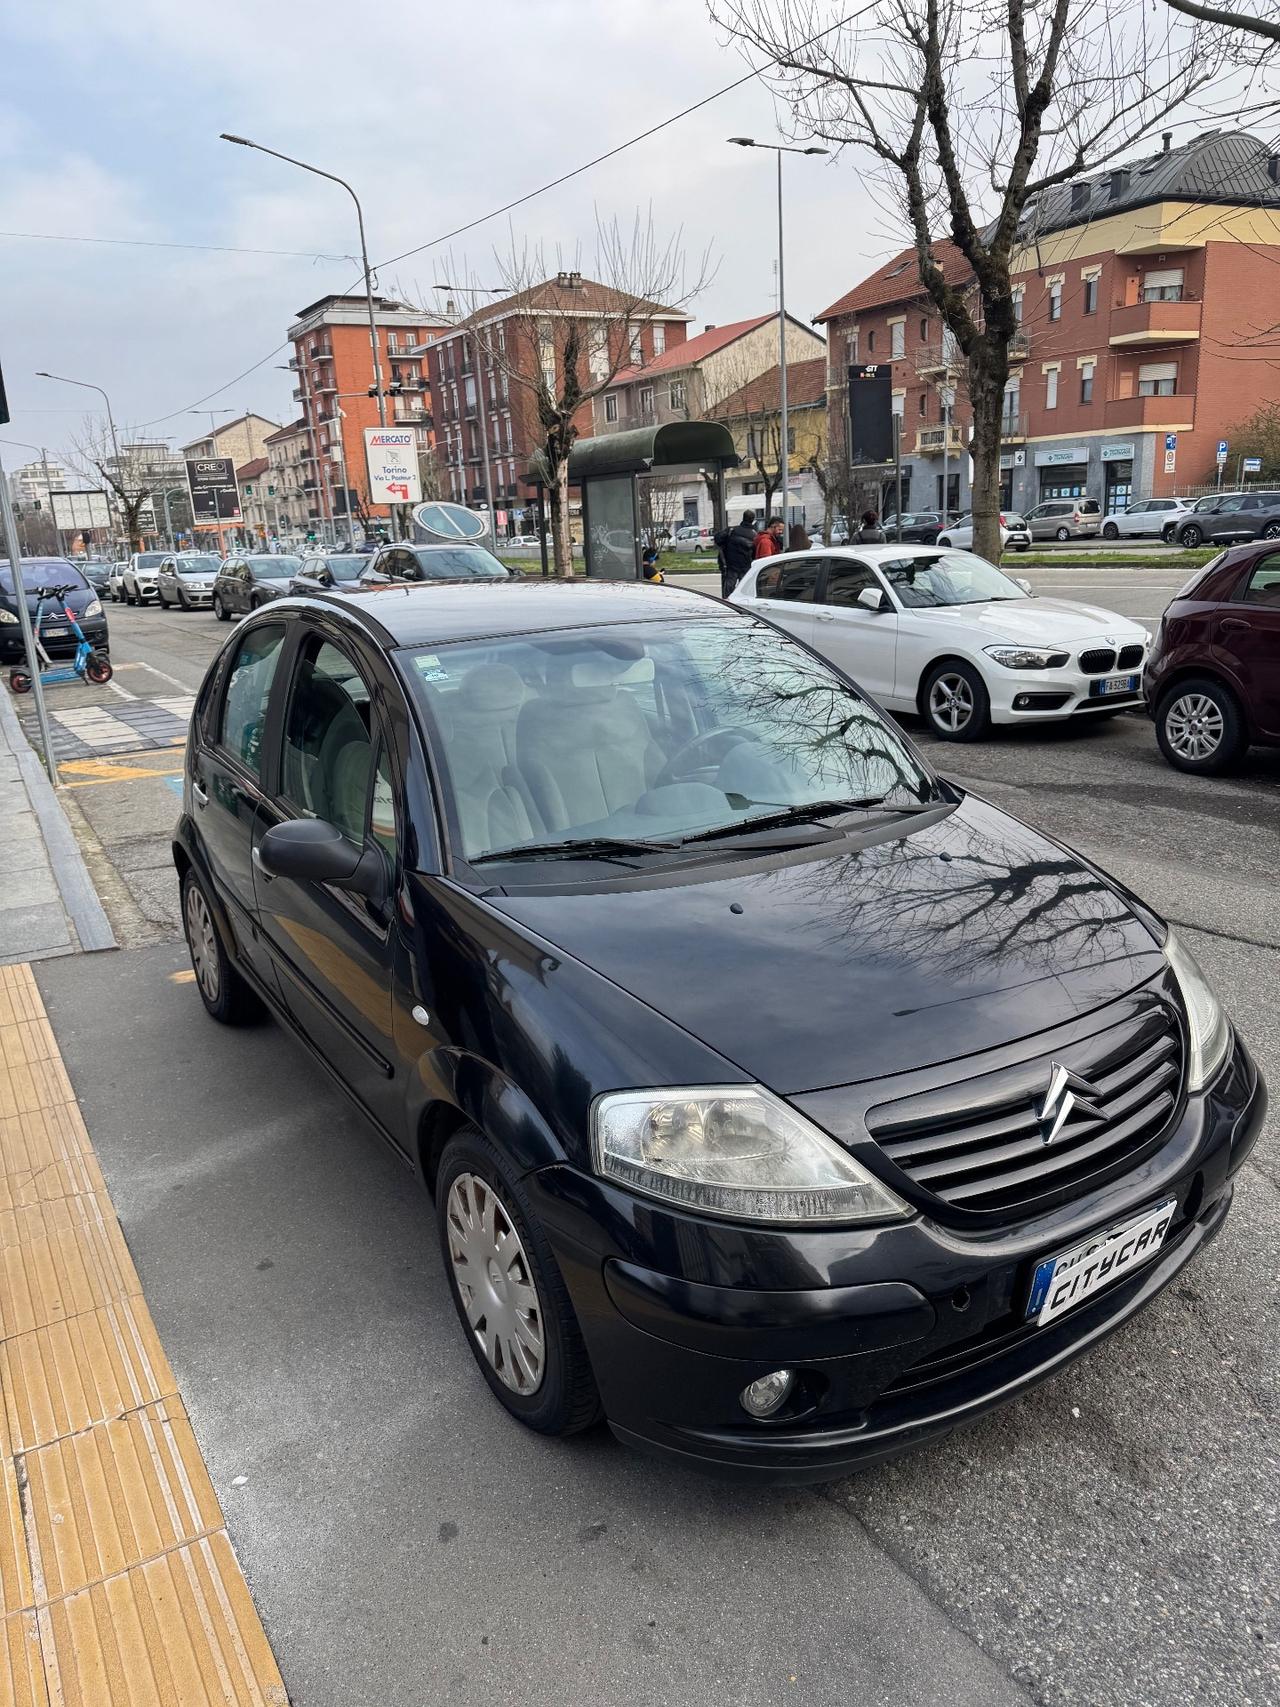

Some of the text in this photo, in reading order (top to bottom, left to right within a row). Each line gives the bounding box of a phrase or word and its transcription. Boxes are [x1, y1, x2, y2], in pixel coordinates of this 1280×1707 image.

[370, 435, 411, 445] MERCATO
[1219, 442, 1226, 451] P
[197, 463, 224, 471] CREO
[382, 465, 407, 474] Torino
[1050, 1216, 1170, 1310] CITYCAR
